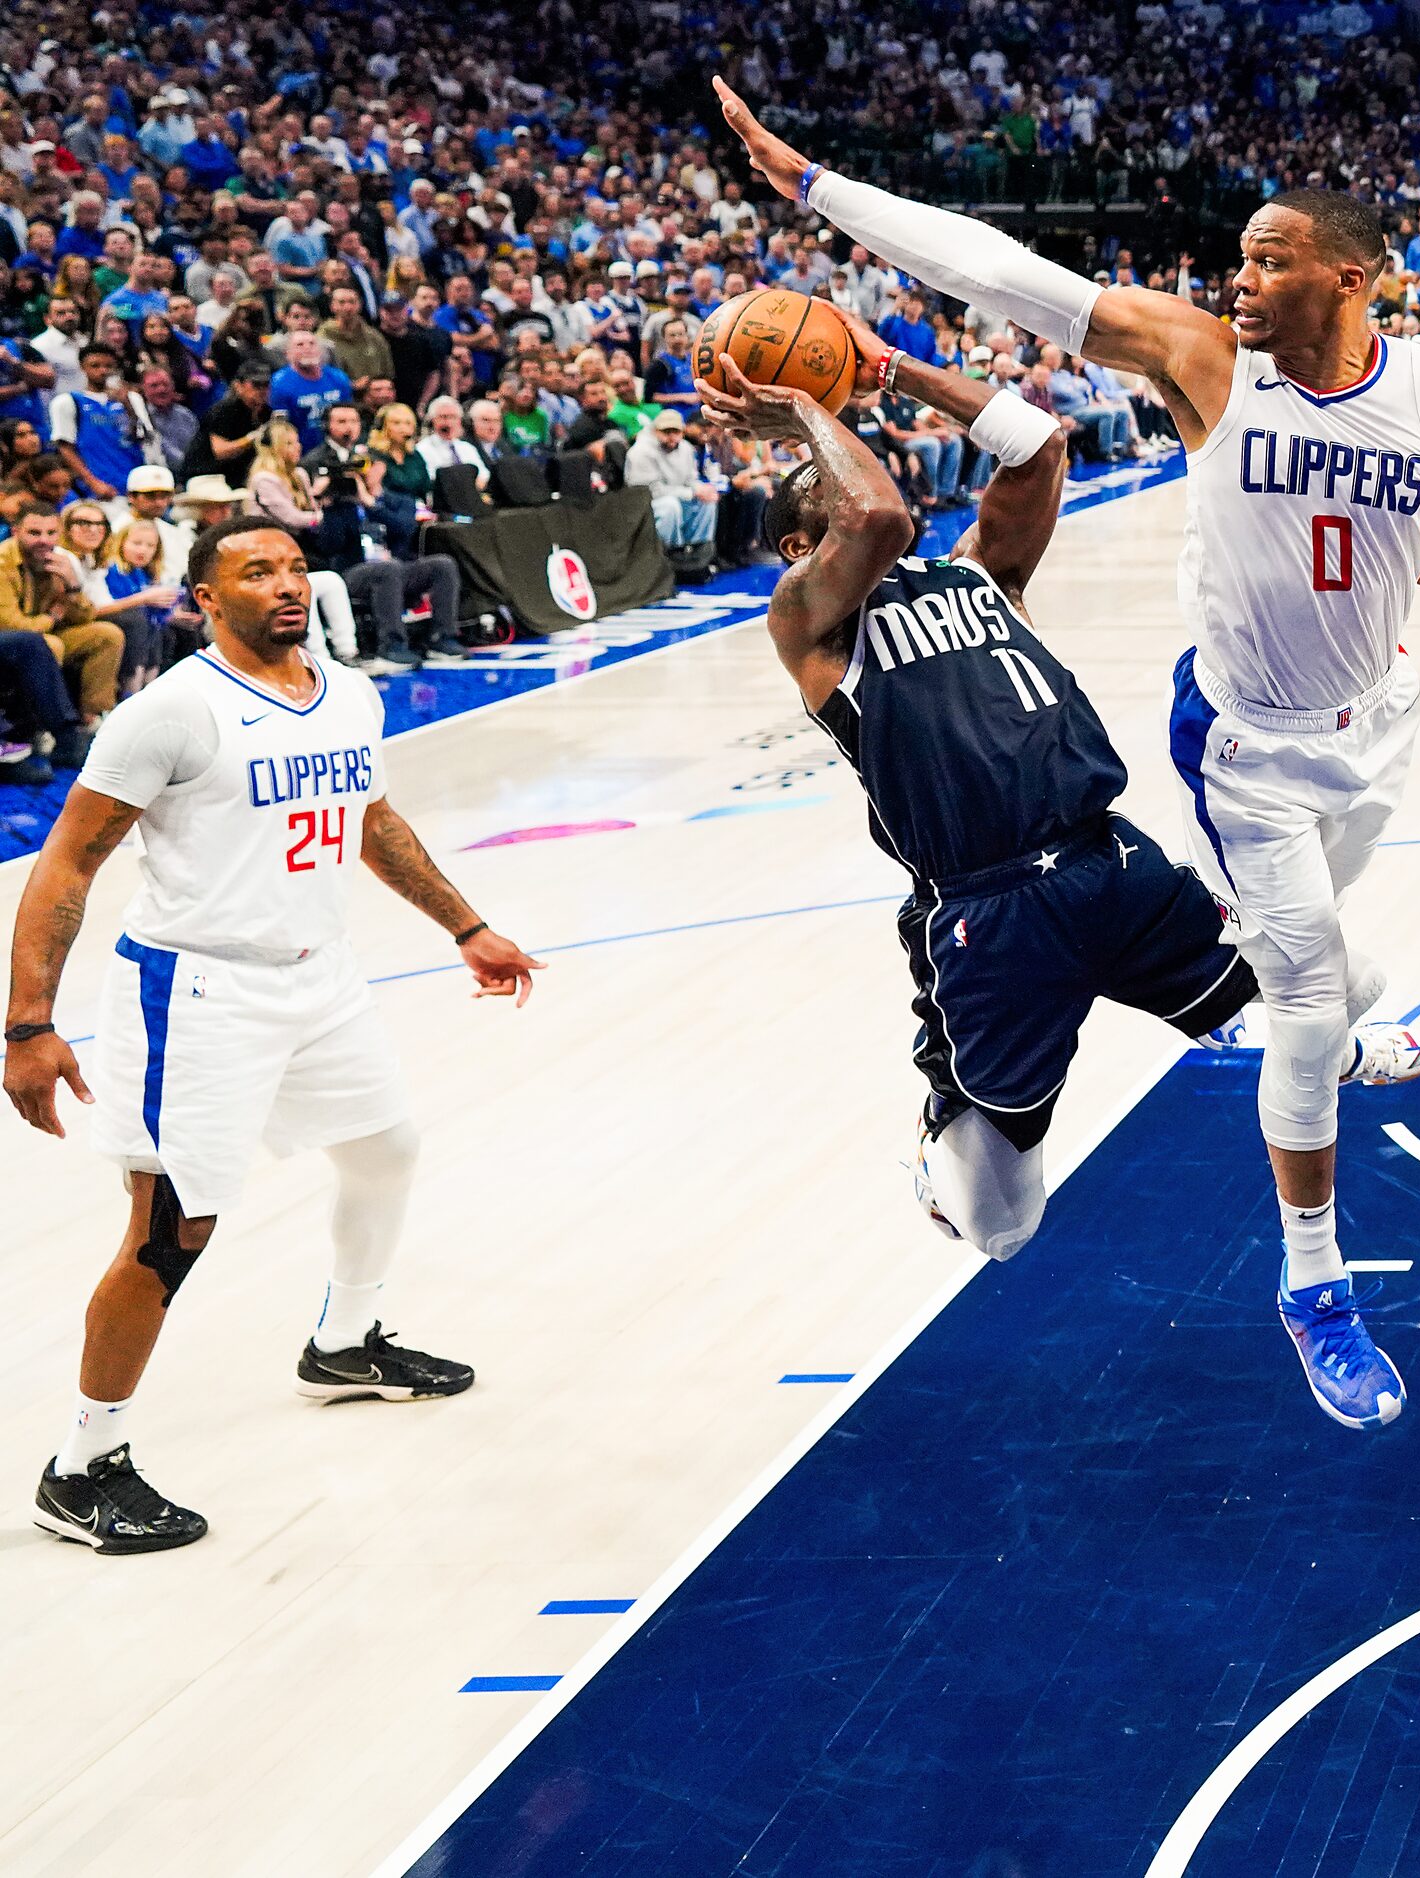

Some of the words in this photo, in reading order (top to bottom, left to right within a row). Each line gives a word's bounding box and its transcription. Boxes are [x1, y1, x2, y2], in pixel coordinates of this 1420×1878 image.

[1312, 514, 1353, 592] 0
[865, 585, 1011, 672] MAVS
[989, 647, 1059, 713] 11
[247, 745, 372, 808] CLIPPERS
[286, 806, 346, 873] 24
